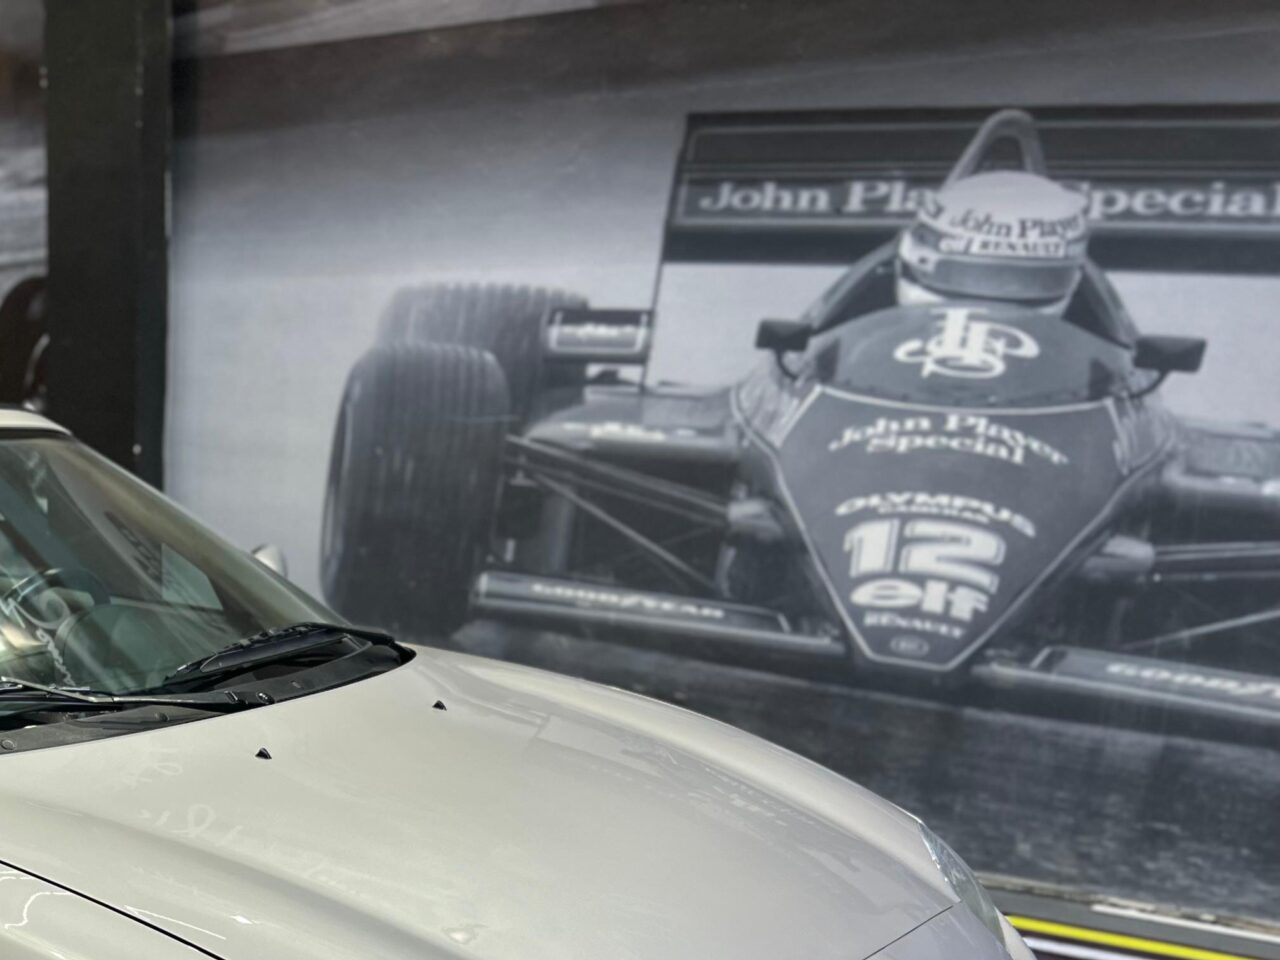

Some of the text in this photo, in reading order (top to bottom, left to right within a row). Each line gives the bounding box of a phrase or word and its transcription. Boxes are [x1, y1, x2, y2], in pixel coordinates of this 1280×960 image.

[699, 180, 831, 213] John
[949, 208, 1012, 238] John
[828, 413, 1068, 466] John Player
[867, 433, 1024, 465] Special
[835, 491, 1036, 538] OLYMPUS
[843, 517, 1007, 595] 12
[850, 577, 990, 622] elf
